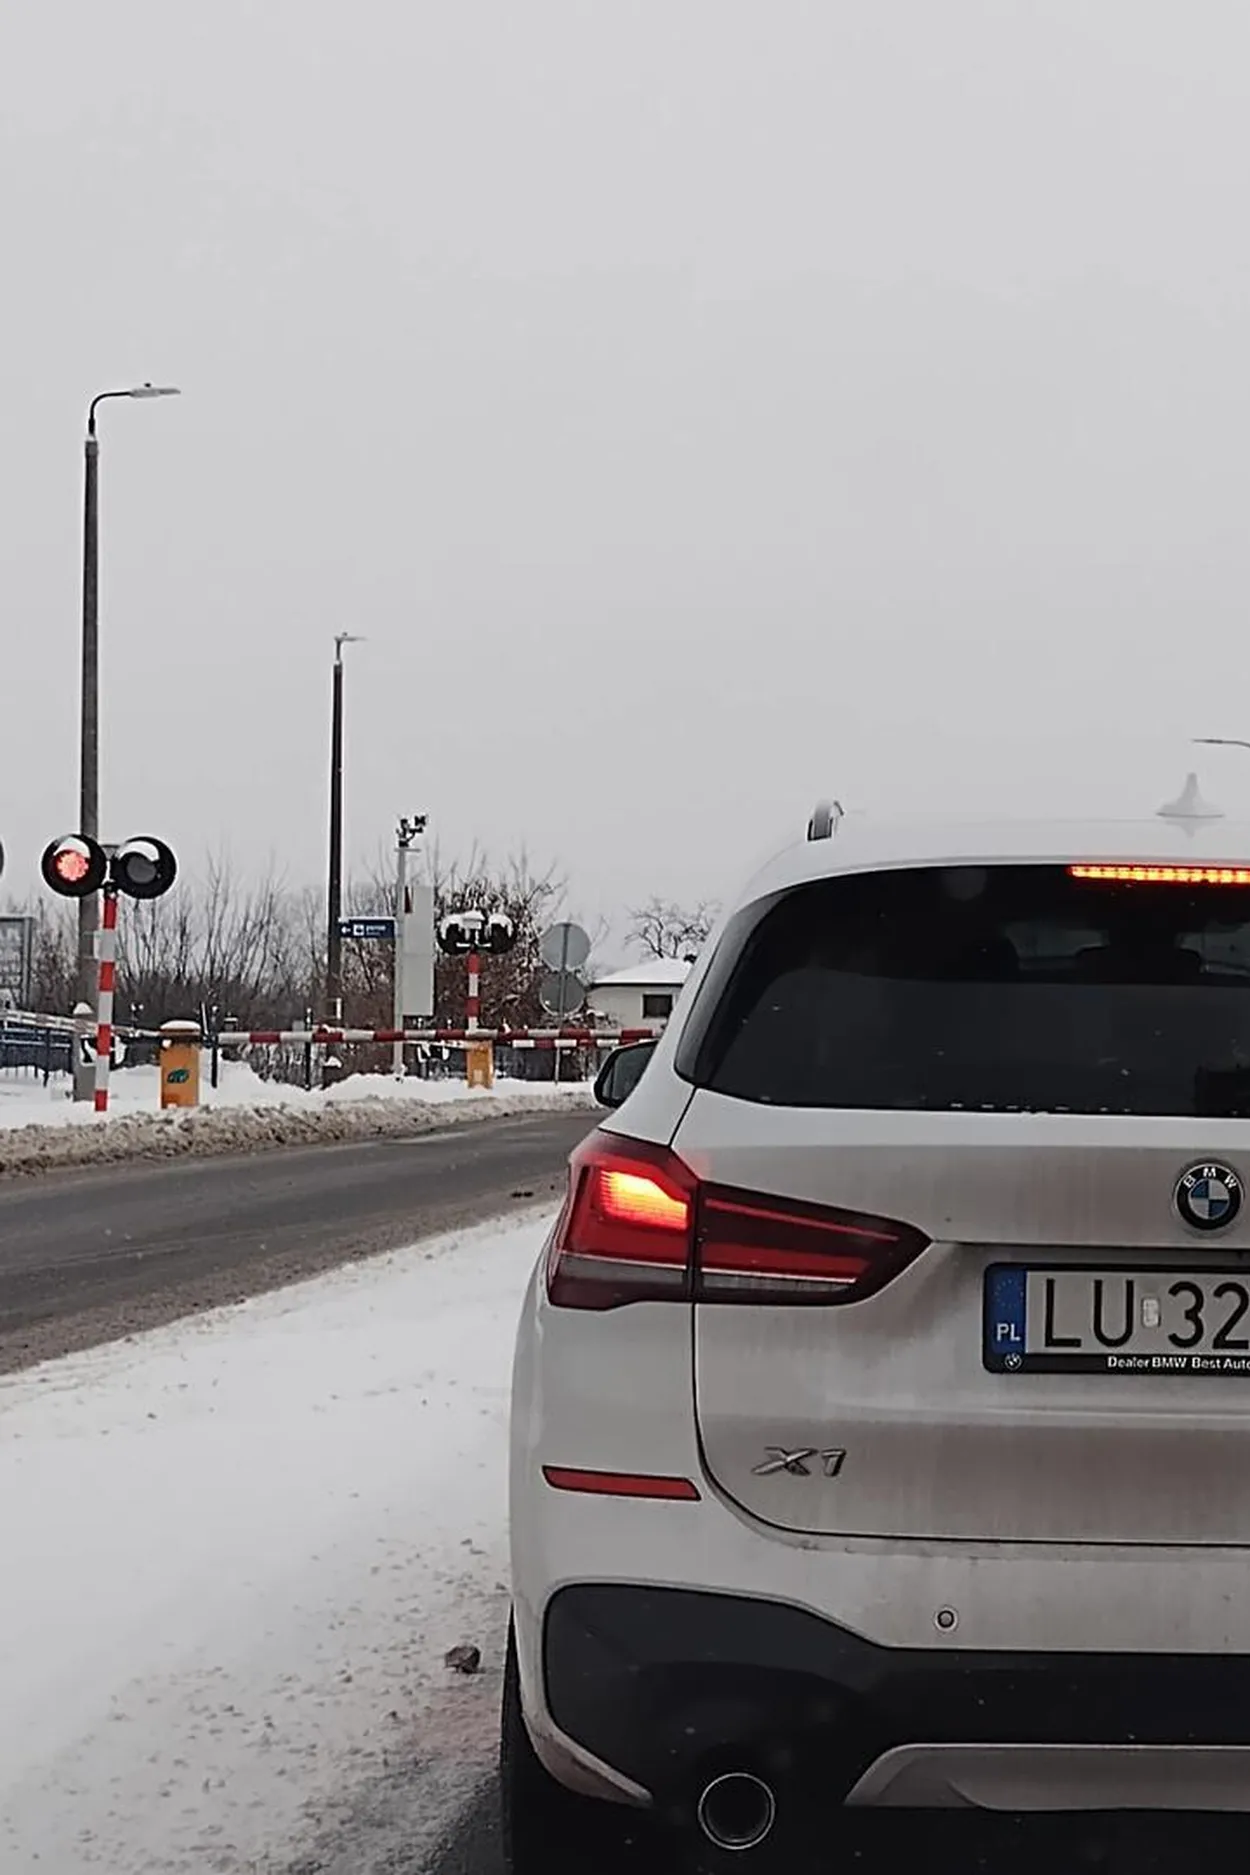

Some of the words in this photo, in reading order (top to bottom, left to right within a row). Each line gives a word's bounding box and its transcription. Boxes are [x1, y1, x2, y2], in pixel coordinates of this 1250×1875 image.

[1183, 1167, 1237, 1188] BMW
[1045, 1278, 1134, 1348] LU
[997, 1323, 1021, 1341] PL
[1107, 1356, 1149, 1368] Dealer
[1152, 1357, 1187, 1368] BMW
[1191, 1357, 1221, 1370] Best
[751, 1446, 847, 1477] X1
